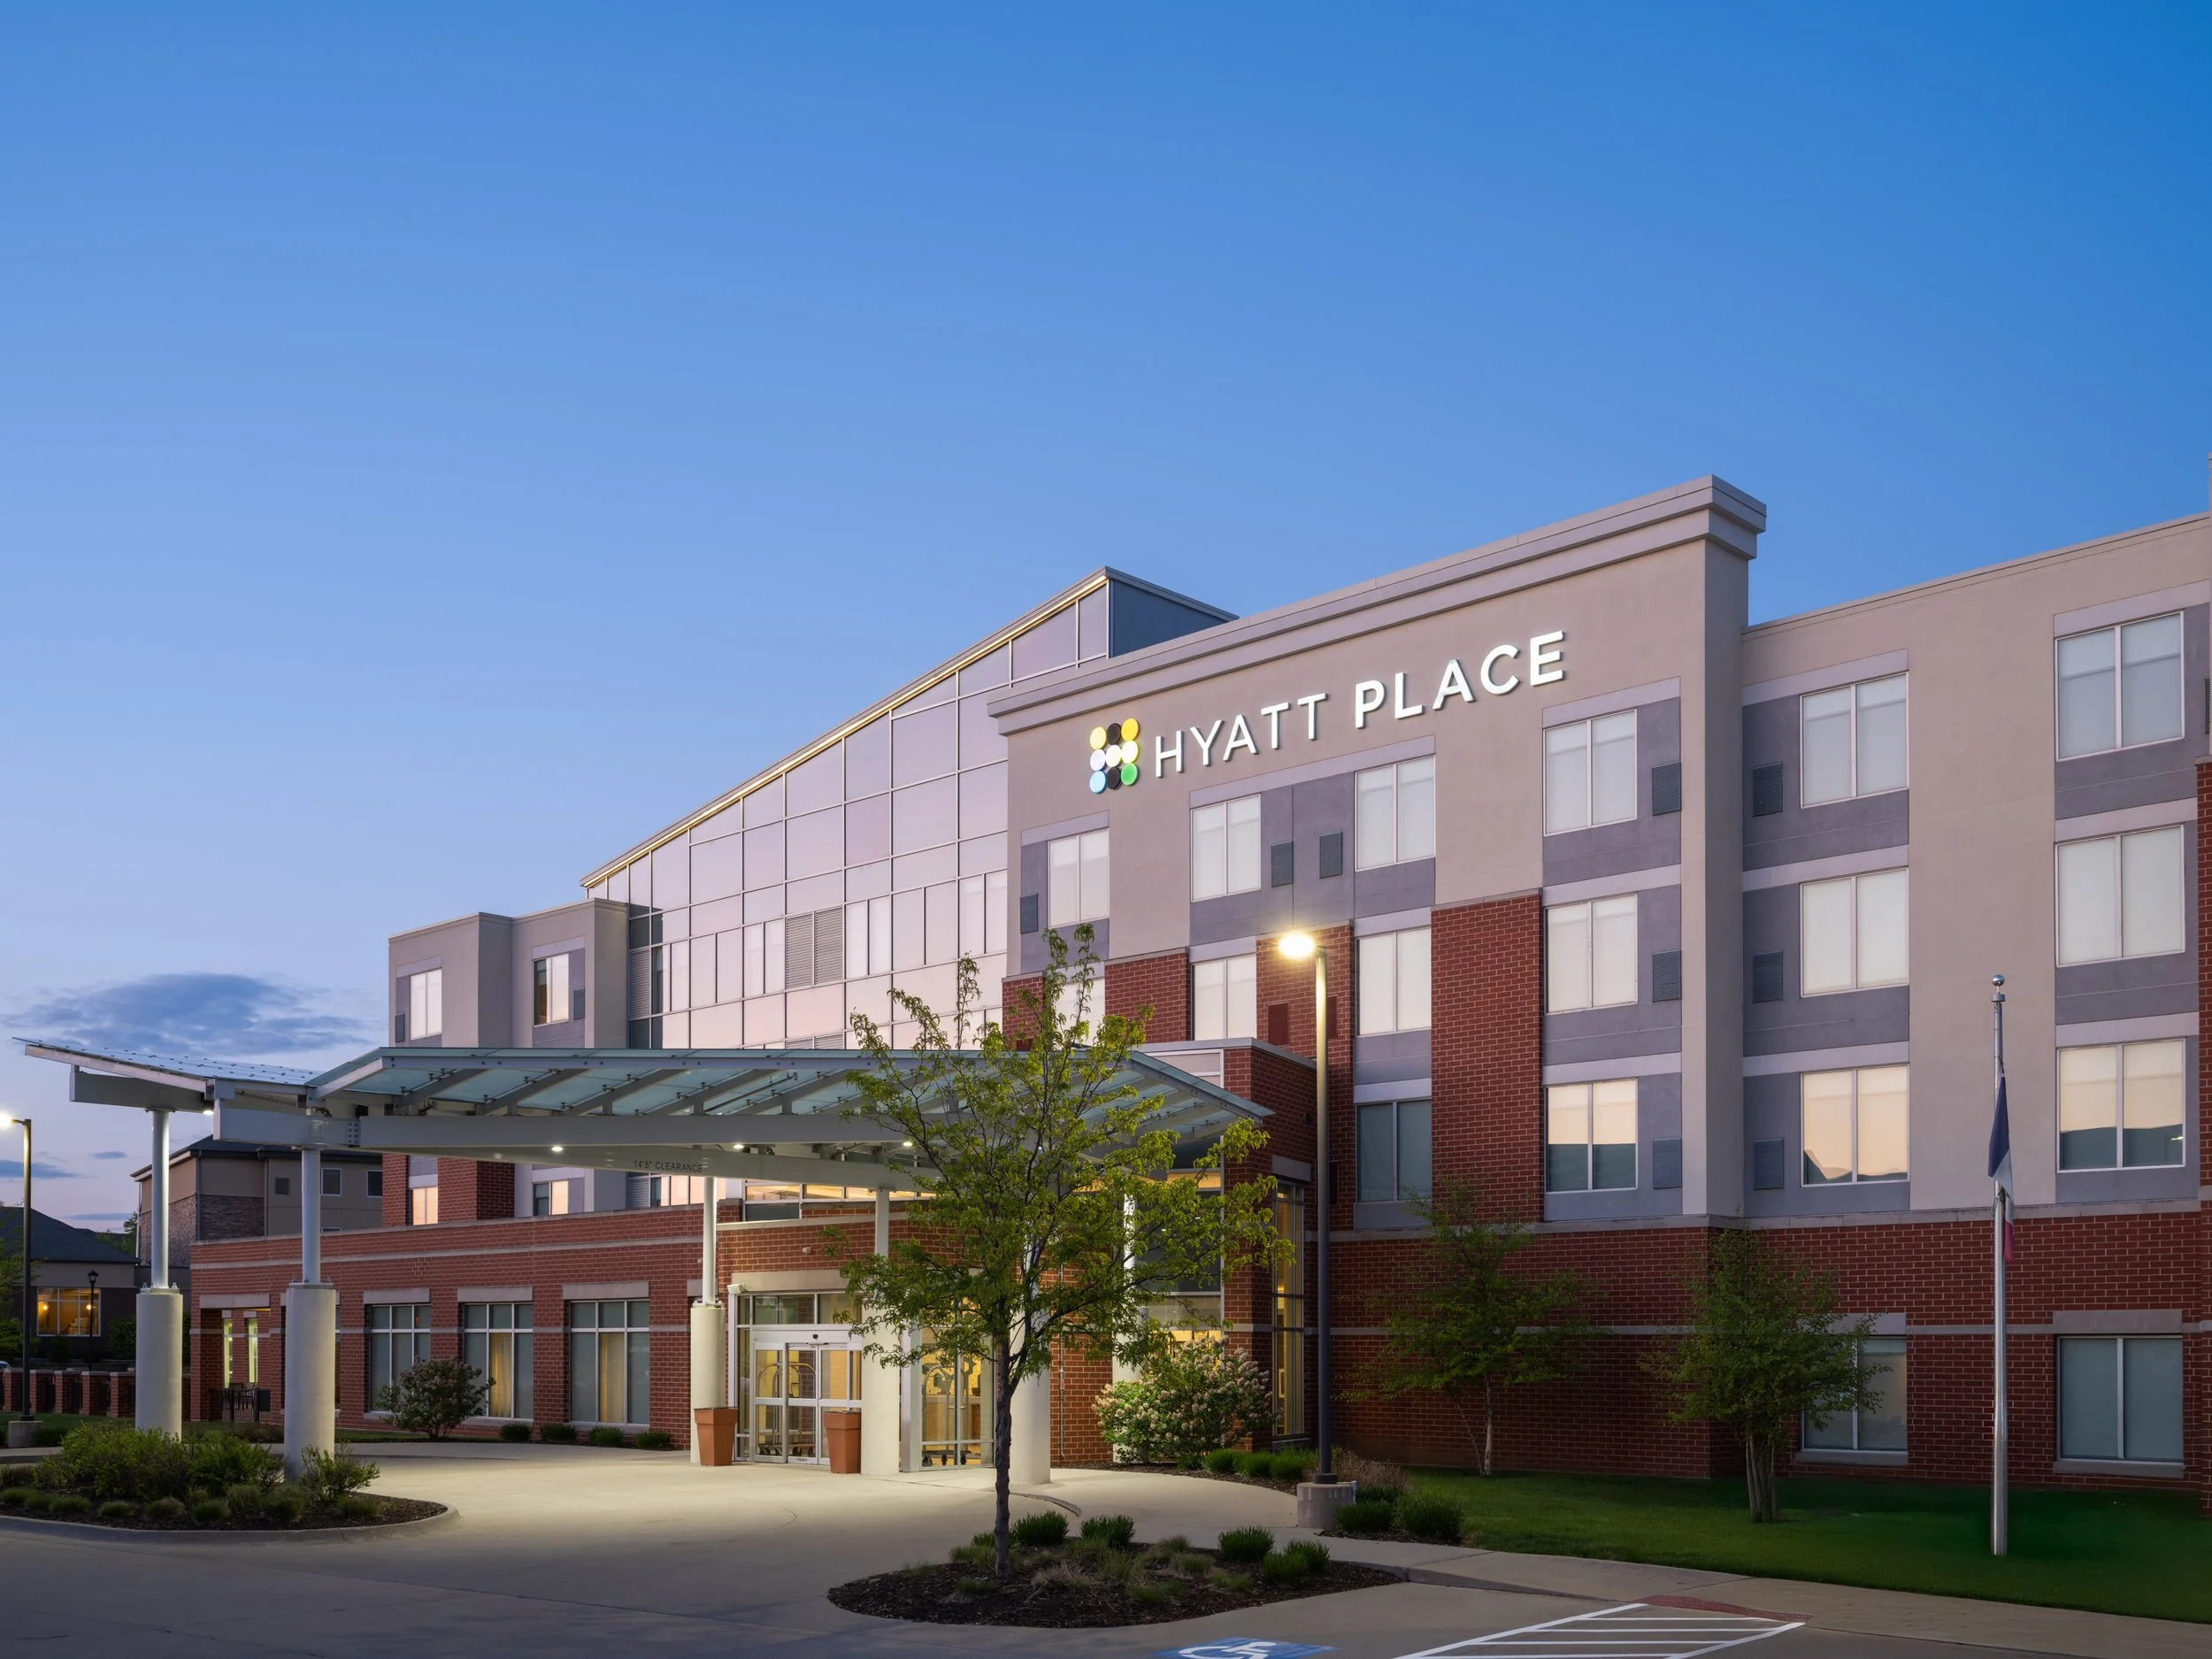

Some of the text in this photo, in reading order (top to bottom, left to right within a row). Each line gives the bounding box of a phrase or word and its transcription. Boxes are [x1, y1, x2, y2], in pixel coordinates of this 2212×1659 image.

[1155, 630, 1566, 779] HYATT PLACE
[655, 1161, 703, 1172] CLEARANCE
